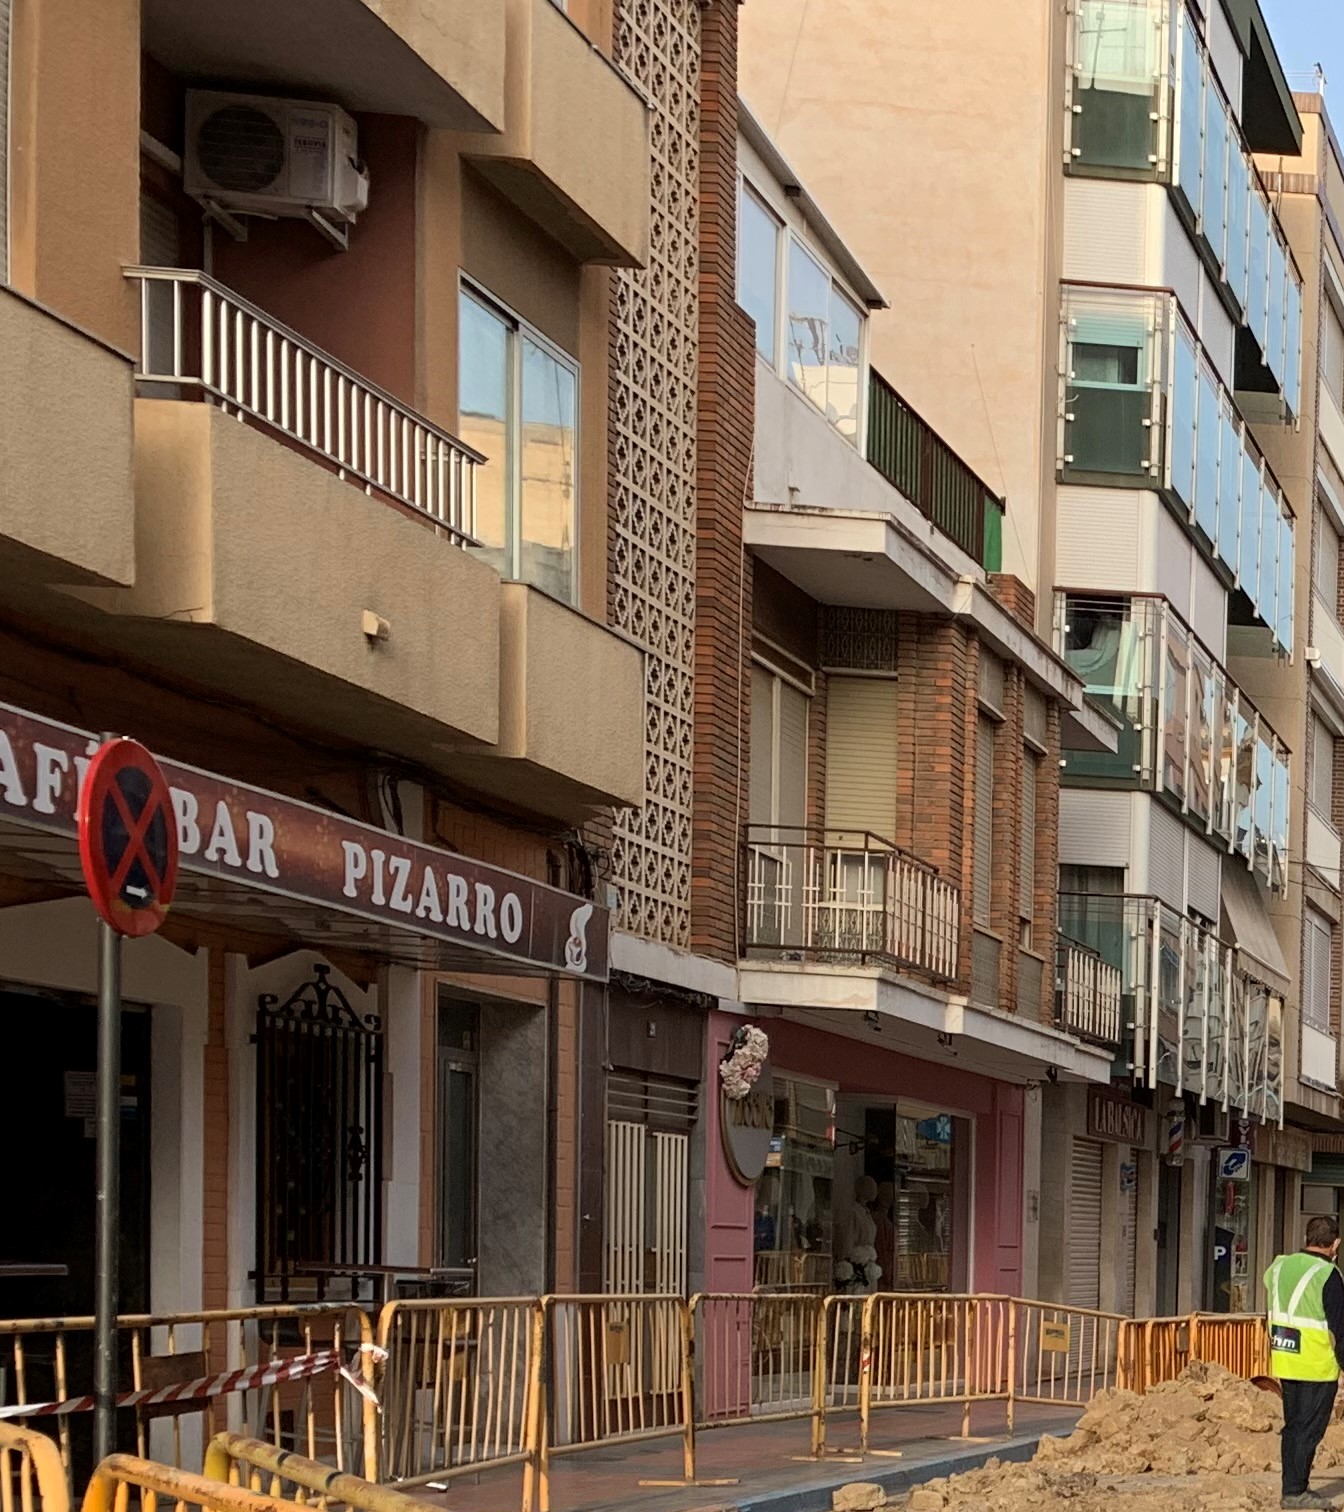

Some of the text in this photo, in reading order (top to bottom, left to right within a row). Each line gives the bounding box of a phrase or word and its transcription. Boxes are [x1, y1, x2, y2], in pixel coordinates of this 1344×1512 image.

[168, 785, 280, 880] BAR
[341, 839, 523, 944] PIZARRO
[1214, 1245, 1227, 1261] P
